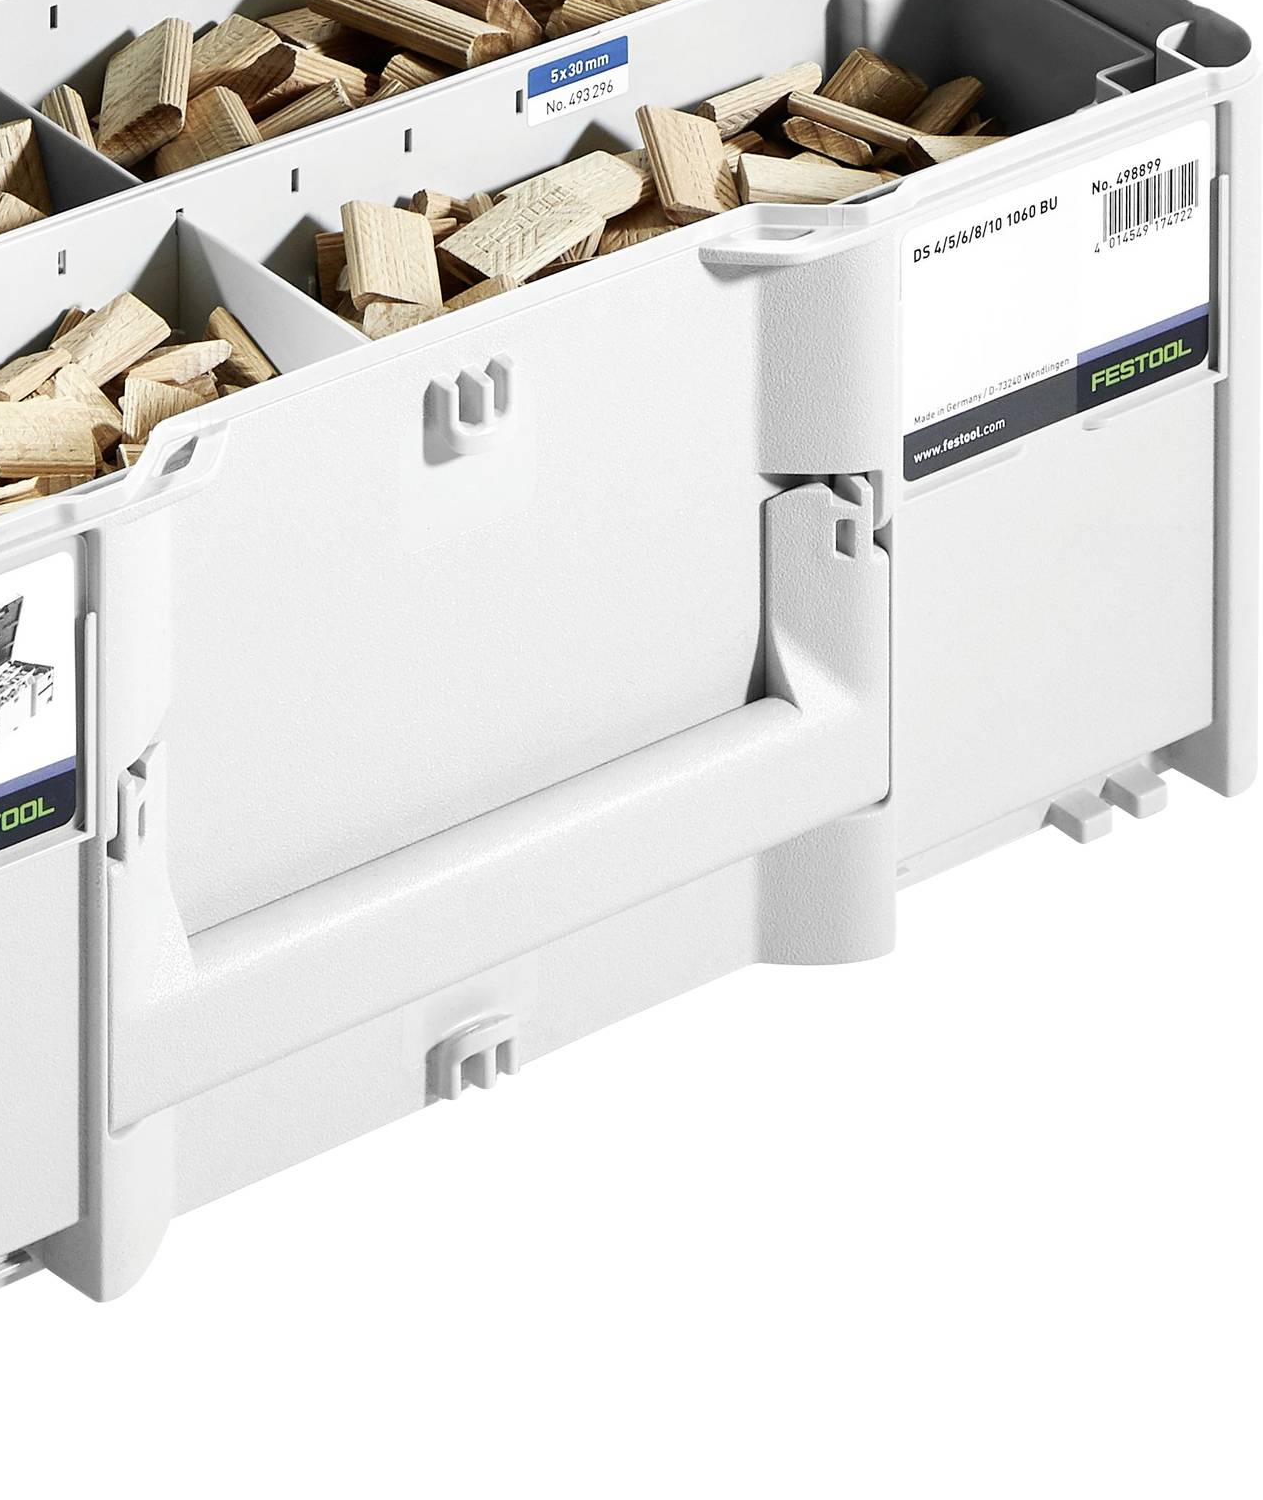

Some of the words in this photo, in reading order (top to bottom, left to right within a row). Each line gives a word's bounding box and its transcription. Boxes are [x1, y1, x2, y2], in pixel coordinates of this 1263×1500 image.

[546, 100, 567, 115] No.
[1092, 181, 1112, 195] No.
[1117, 158, 1160, 184] 498899
[914, 245, 930, 263] DS
[934, 218, 1002, 253] 4/5/6/8/10
[1007, 205, 1035, 226] 1060
[1041, 196, 1057, 214] BU
[1090, 338, 1192, 392] FESTOOL
[914, 412, 935, 424] Made
[947, 394, 981, 412] Germany
[989, 375, 1021, 395] D-73240
[1023, 359, 1069, 381] Wendlingen
[914, 419, 1005, 463] www.festool.com
